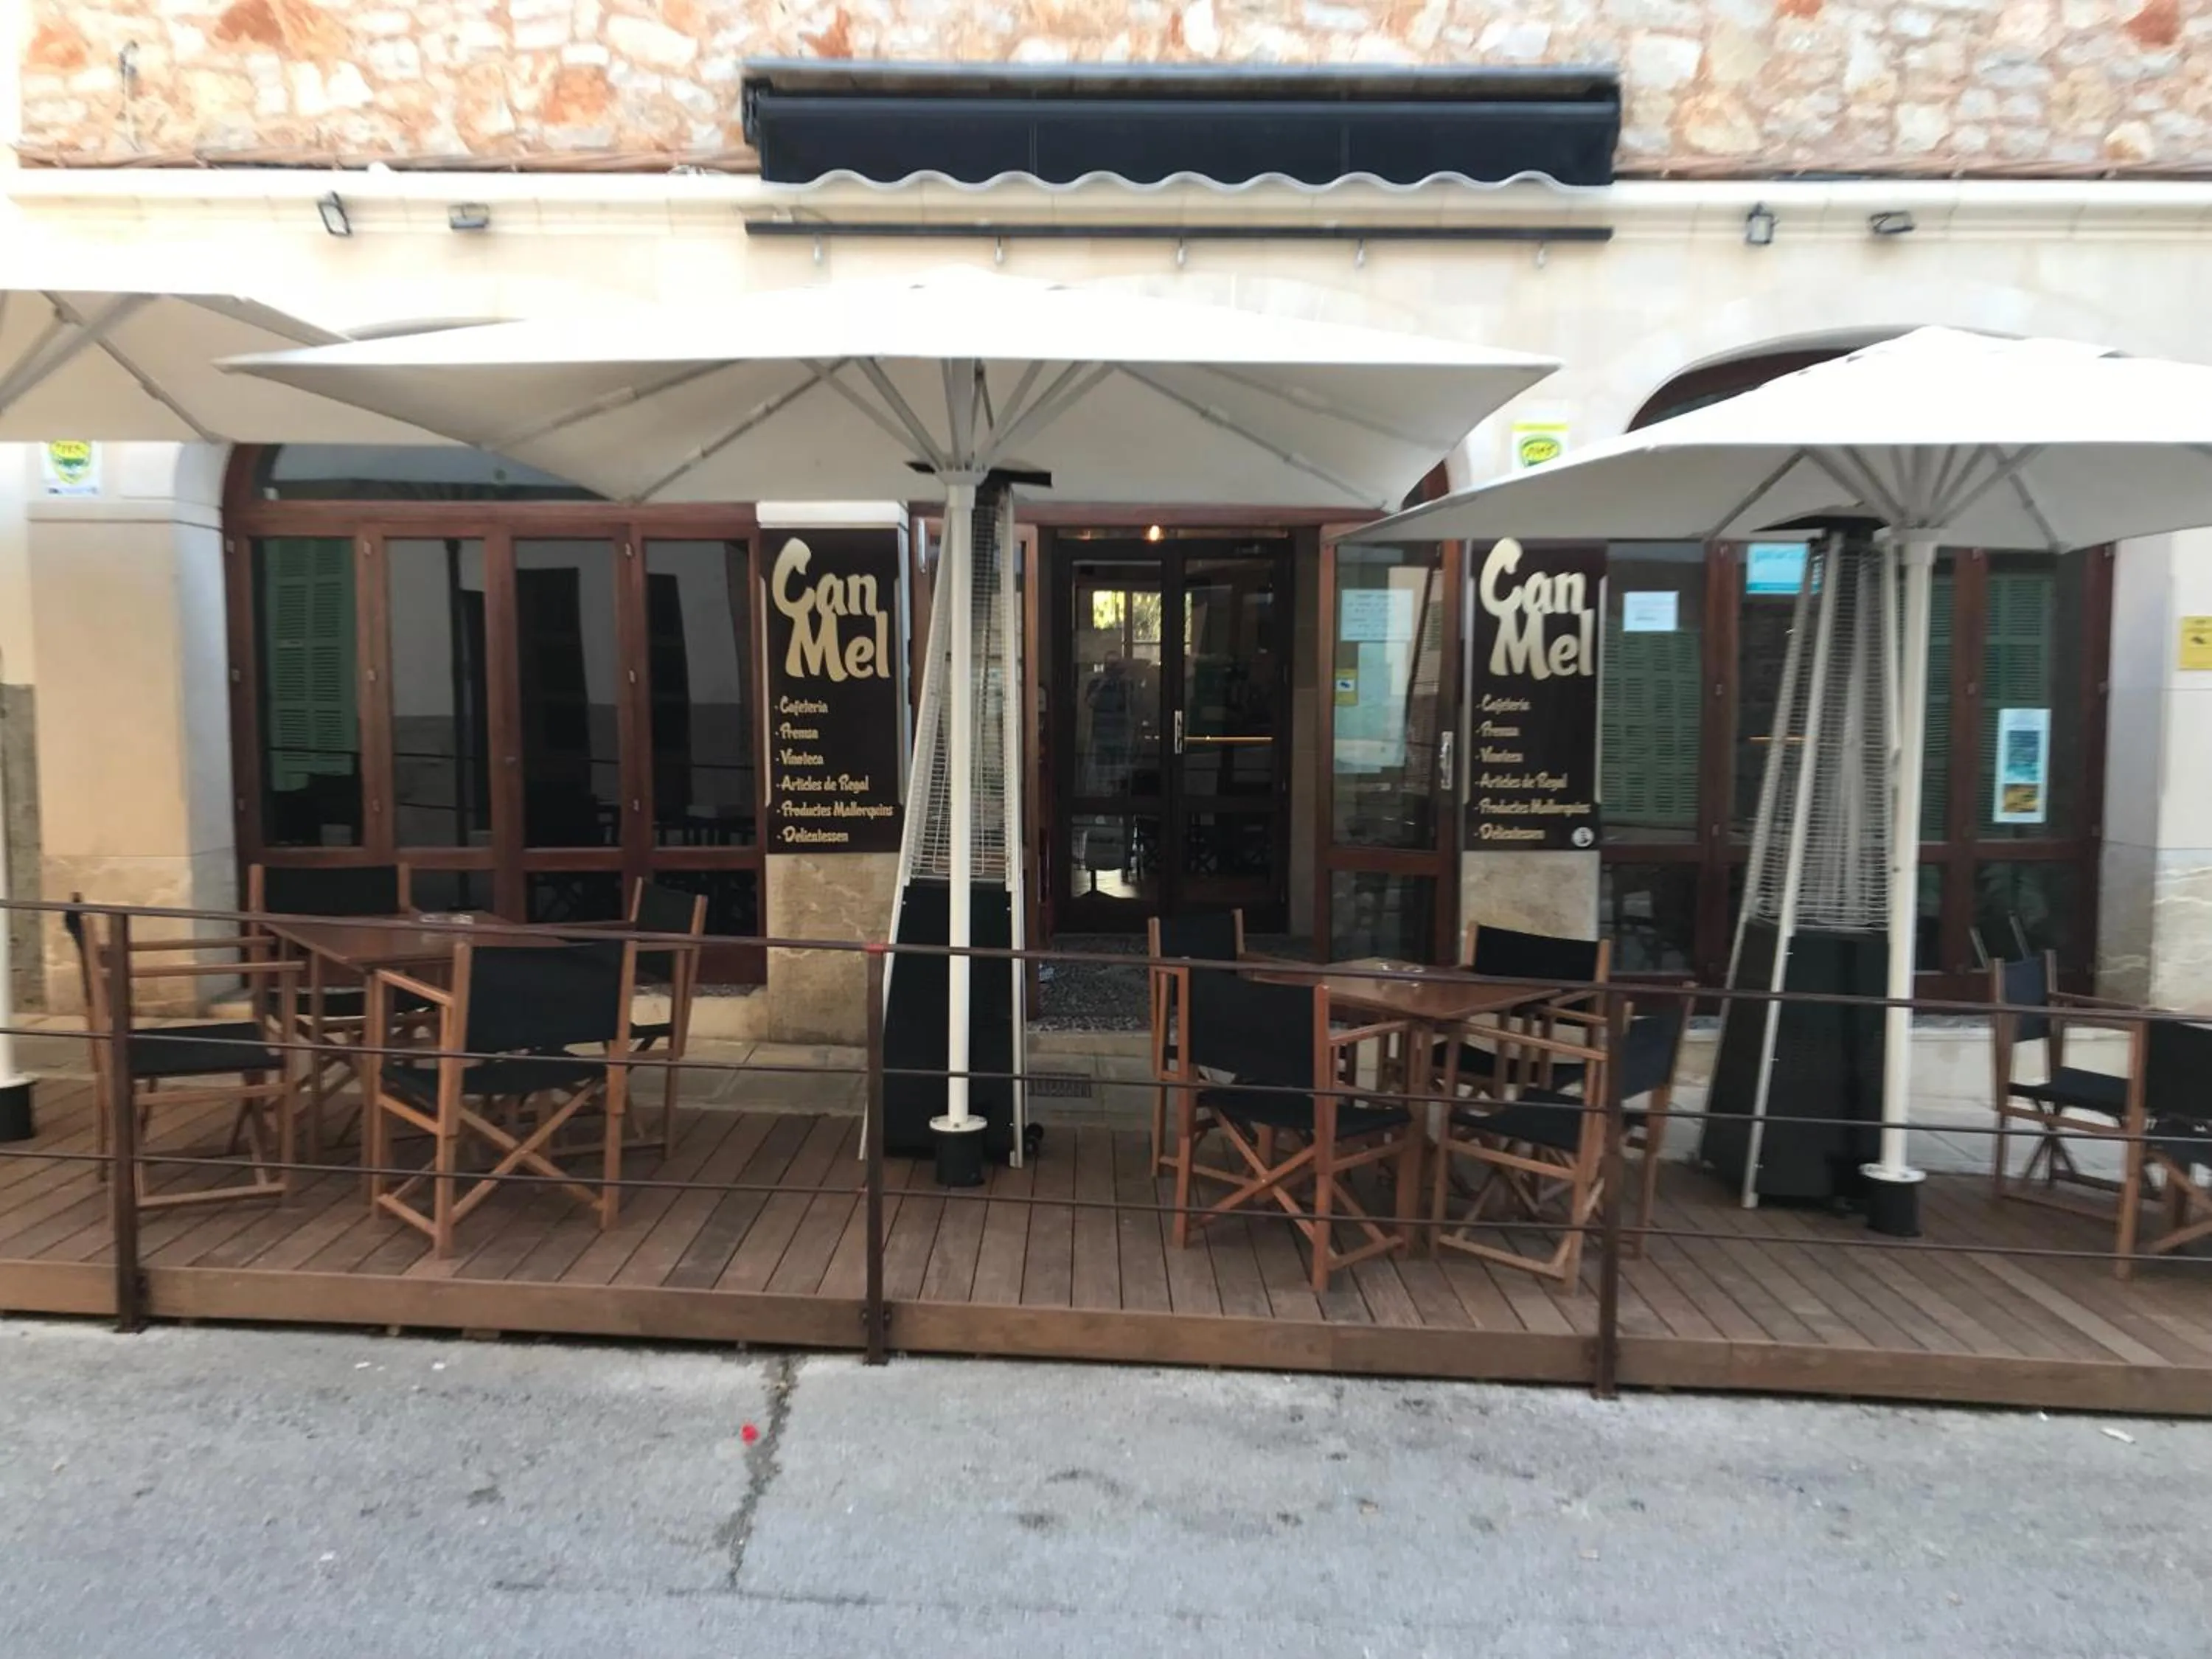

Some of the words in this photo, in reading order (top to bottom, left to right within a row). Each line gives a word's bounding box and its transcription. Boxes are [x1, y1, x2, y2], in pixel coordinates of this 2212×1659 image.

[772, 537, 877, 617] Can
[1479, 537, 1586, 617] Can
[785, 610, 891, 682] Mel
[1489, 608, 1596, 681] Mel
[824, 775, 837, 791] de
[838, 773, 869, 794] Regal
